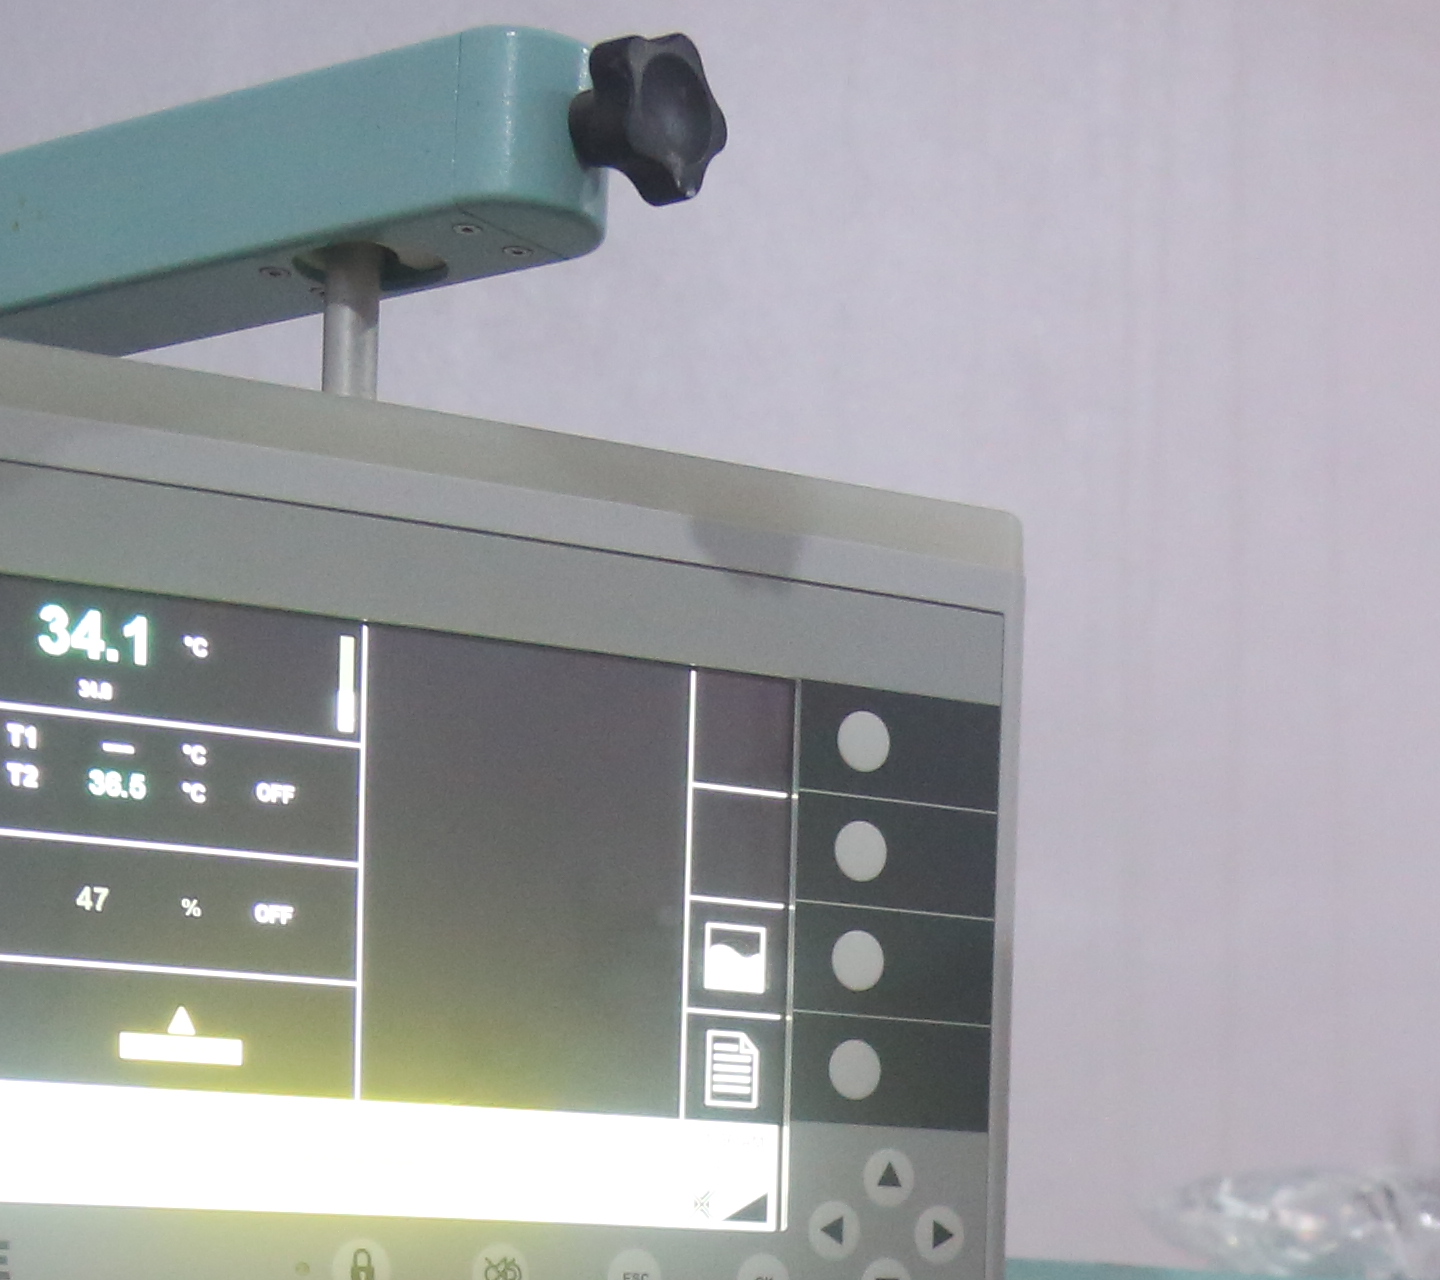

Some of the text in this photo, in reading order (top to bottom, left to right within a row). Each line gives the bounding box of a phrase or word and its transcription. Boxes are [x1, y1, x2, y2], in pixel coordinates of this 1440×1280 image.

[37, 604, 148, 666] 34.1
[6, 722, 37, 749] T1
[6, 762, 39, 788] T2
[88, 769, 146, 800] 36.5
[255, 782, 296, 804] OFF
[76, 886, 294, 925] 47 % OFF
